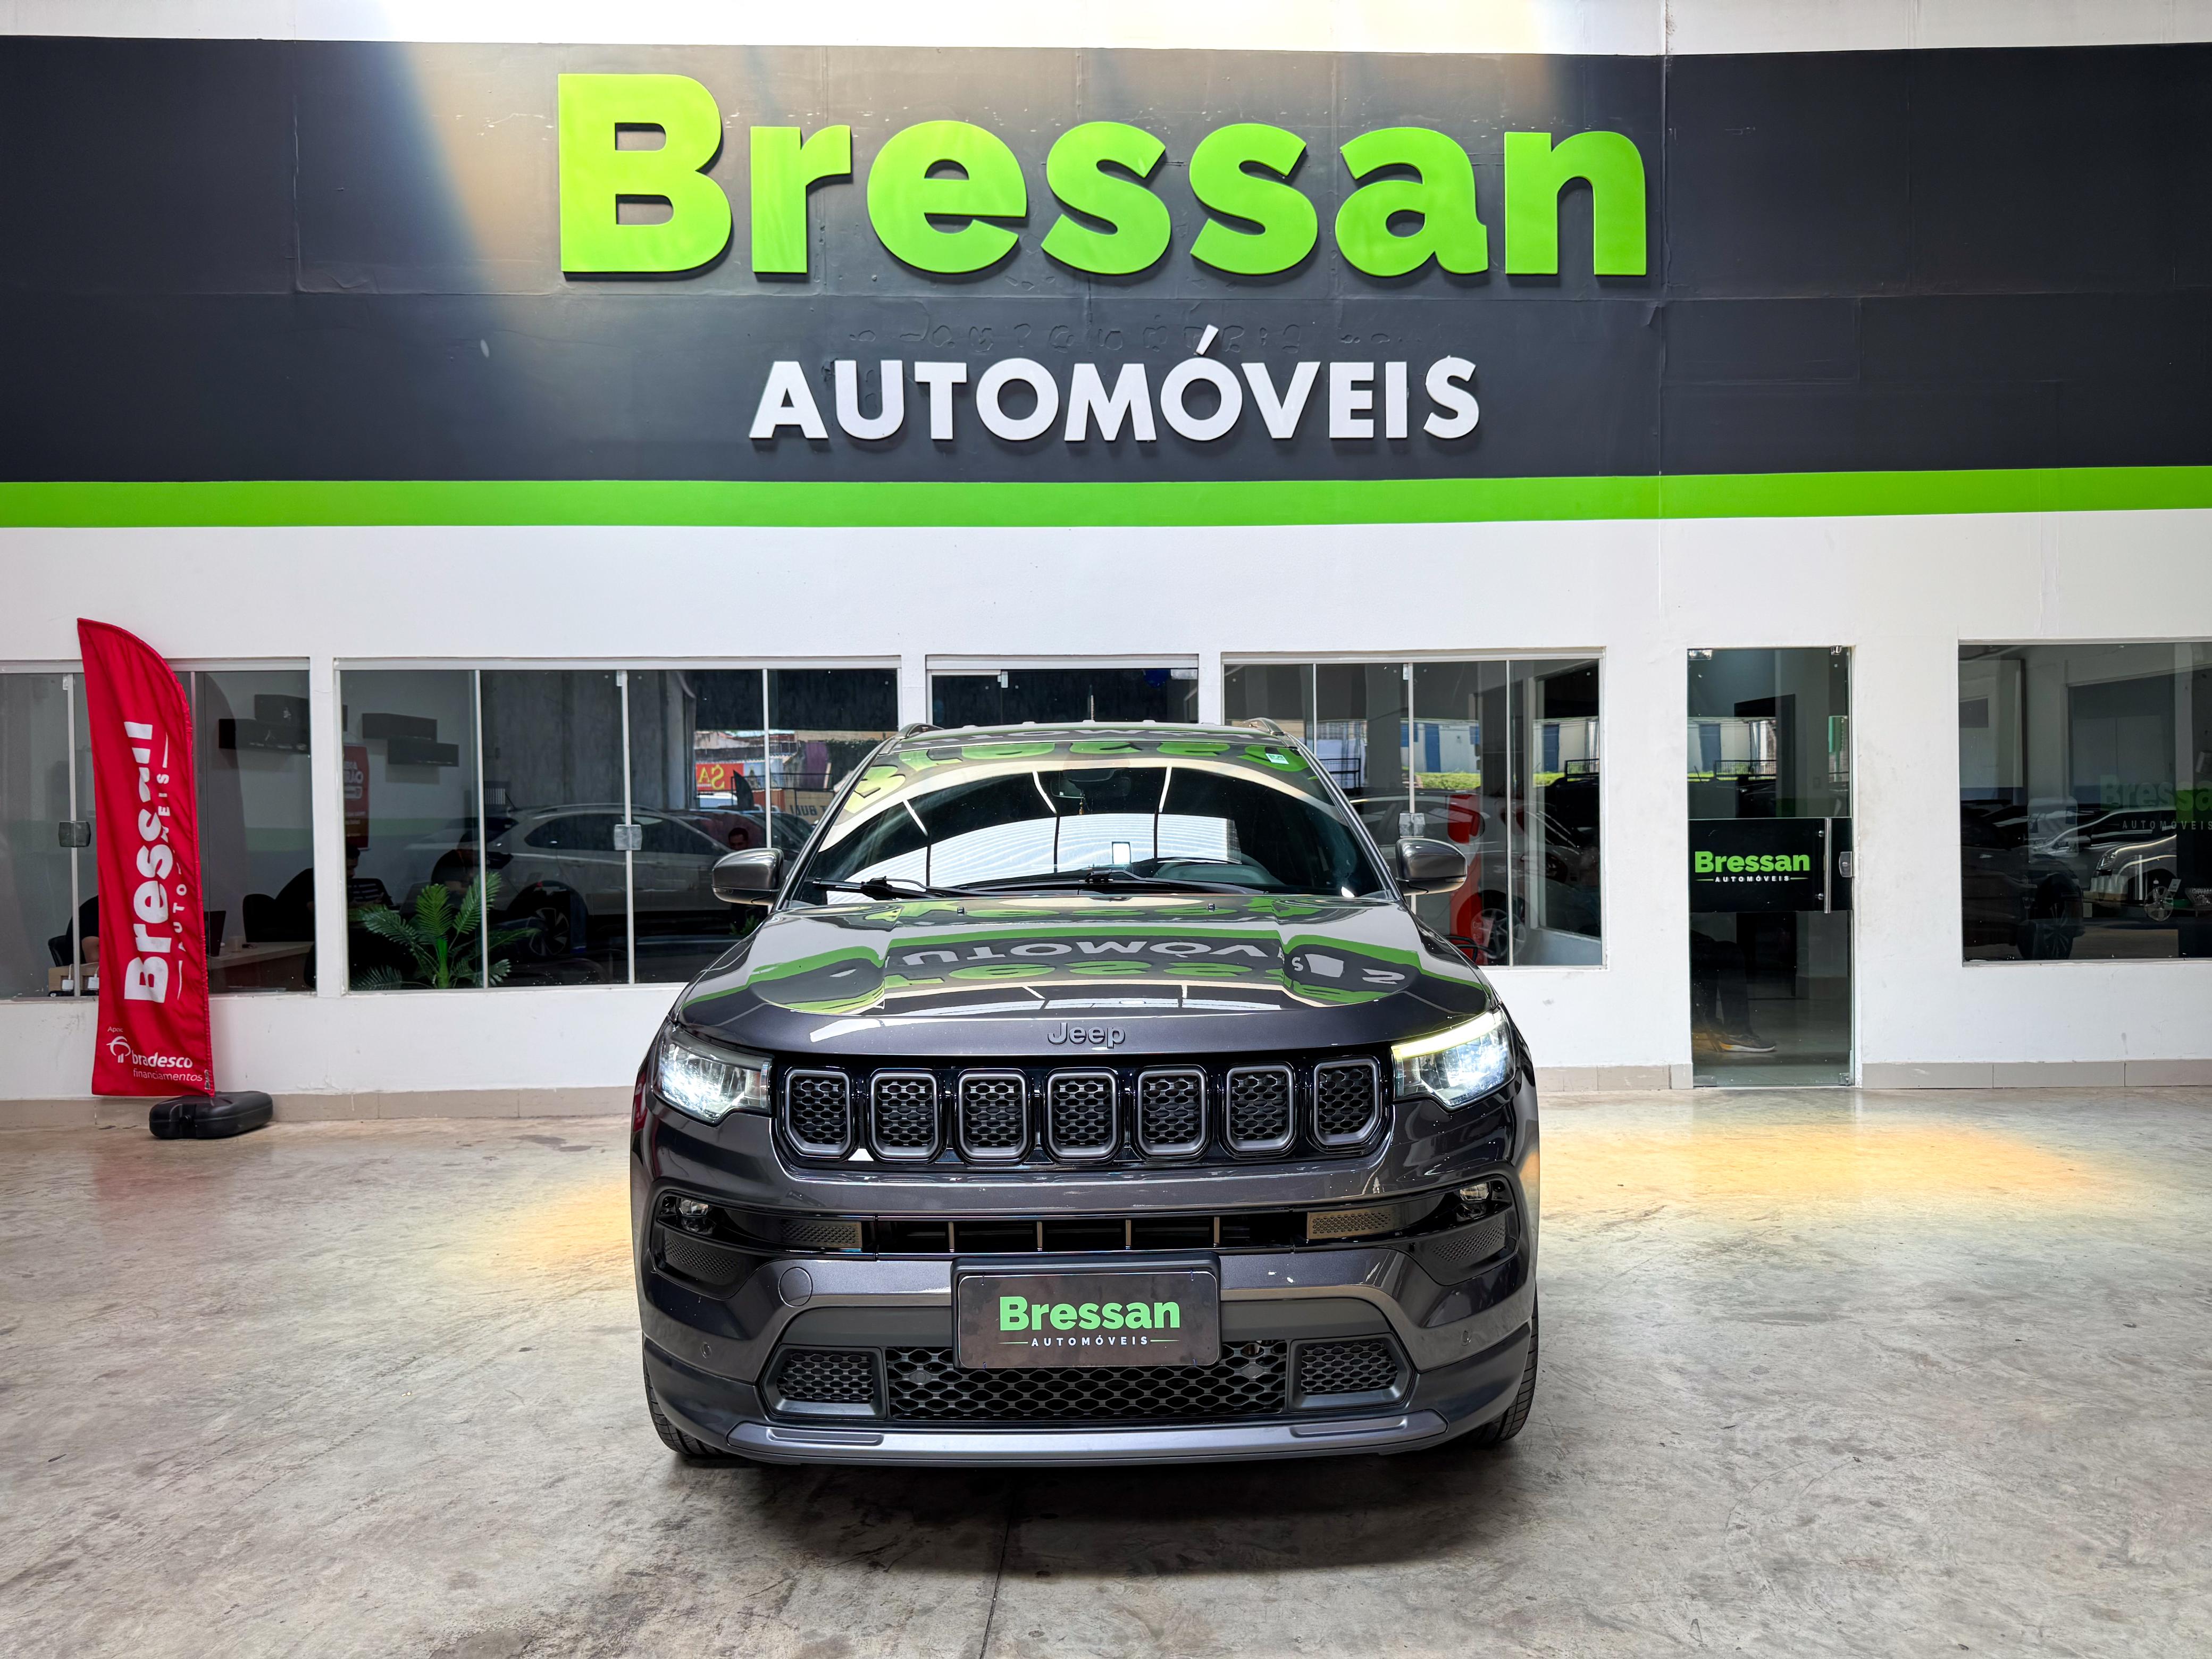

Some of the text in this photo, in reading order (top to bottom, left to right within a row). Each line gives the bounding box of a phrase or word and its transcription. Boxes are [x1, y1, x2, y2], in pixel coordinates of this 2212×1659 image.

[558, 73, 1647, 276] Bressan
[748, 324, 1480, 443] AUTOMÓVEIS
[1695, 851, 1810, 873] Bressan
[1048, 1022, 1126, 1049] Jeep
[131, 1050, 193, 1068] bradesco
[133, 1068, 203, 1082] financiamentos
[1000, 1296, 1180, 1331] Bressan
[1031, 1335, 1148, 1347] AUTOMÓVEIS
